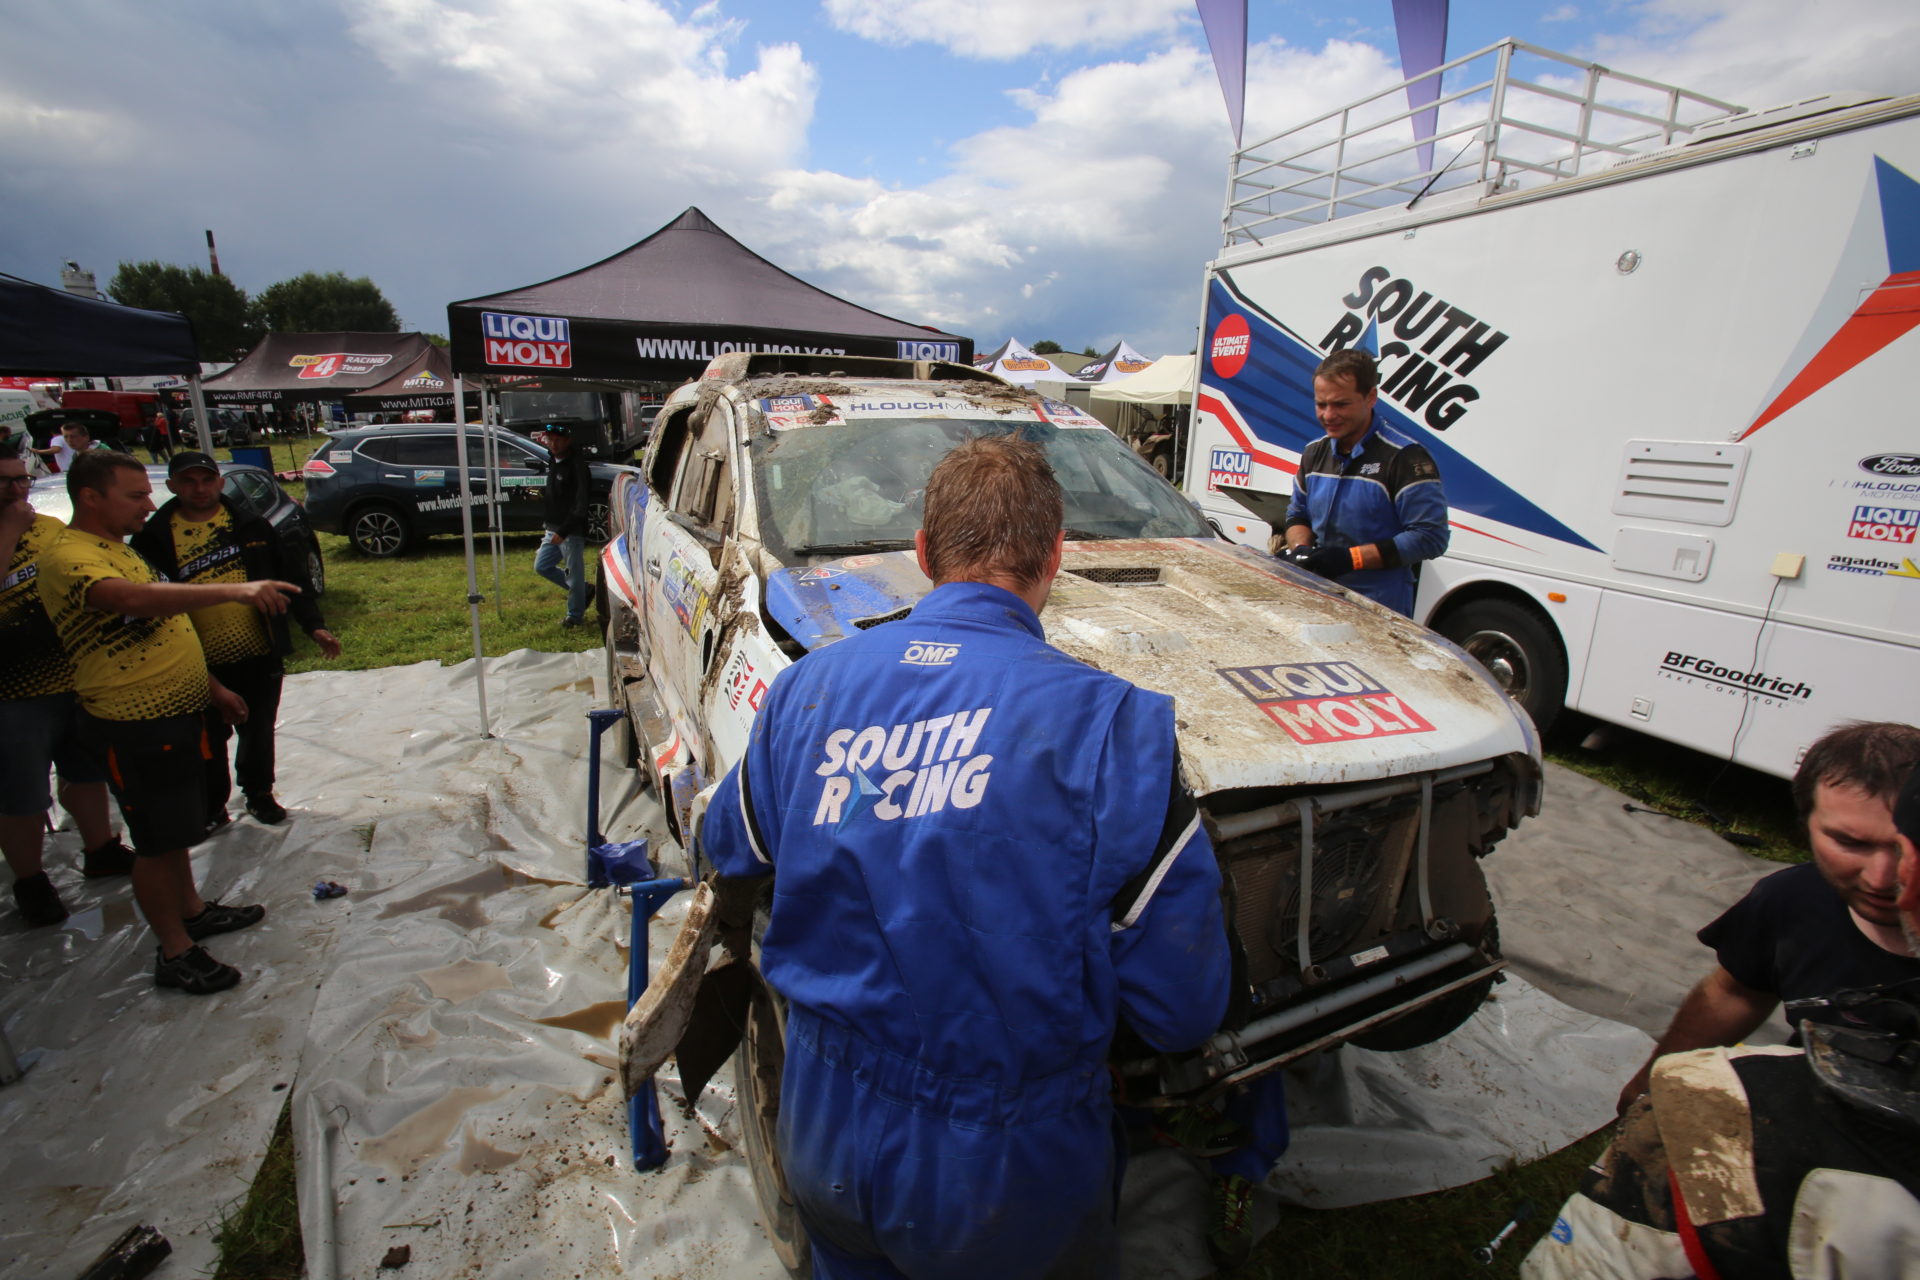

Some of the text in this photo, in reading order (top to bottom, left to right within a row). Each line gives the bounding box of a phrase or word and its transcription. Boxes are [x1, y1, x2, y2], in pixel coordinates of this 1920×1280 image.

[487, 315, 565, 341] LIQUI
[1342, 265, 1509, 377] SOUTH
[1214, 334, 1249, 346] ULTIMATE
[490, 341, 568, 365] MOLY
[902, 343, 956, 362] LIQUI
[1211, 344, 1246, 357] EVENTS
[313, 357, 336, 375] 4
[345, 356, 384, 365] RACING
[341, 364, 366, 372] Team
[1318, 311, 1480, 431] RCING
[403, 378, 444, 387] MITKO
[1212, 451, 1250, 473] LIQUI
[1210, 472, 1249, 489] MOLY
[1854, 481, 1920, 493] HLOUC
[1855, 506, 1919, 526] LIQUI
[1850, 522, 1916, 542] MOLY
[1830, 555, 1900, 570] agados
[904, 645, 959, 662] OMP
[1224, 663, 1382, 700] LIQUI
[1662, 651, 1812, 699] BFGoodrich
[1657, 670, 1693, 685] TAKE
[1704, 683, 1785, 708] CONTROL
[1268, 696, 1421, 741] MOLY
[815, 707, 992, 776] SOUTH
[813, 753, 993, 827] RCING
